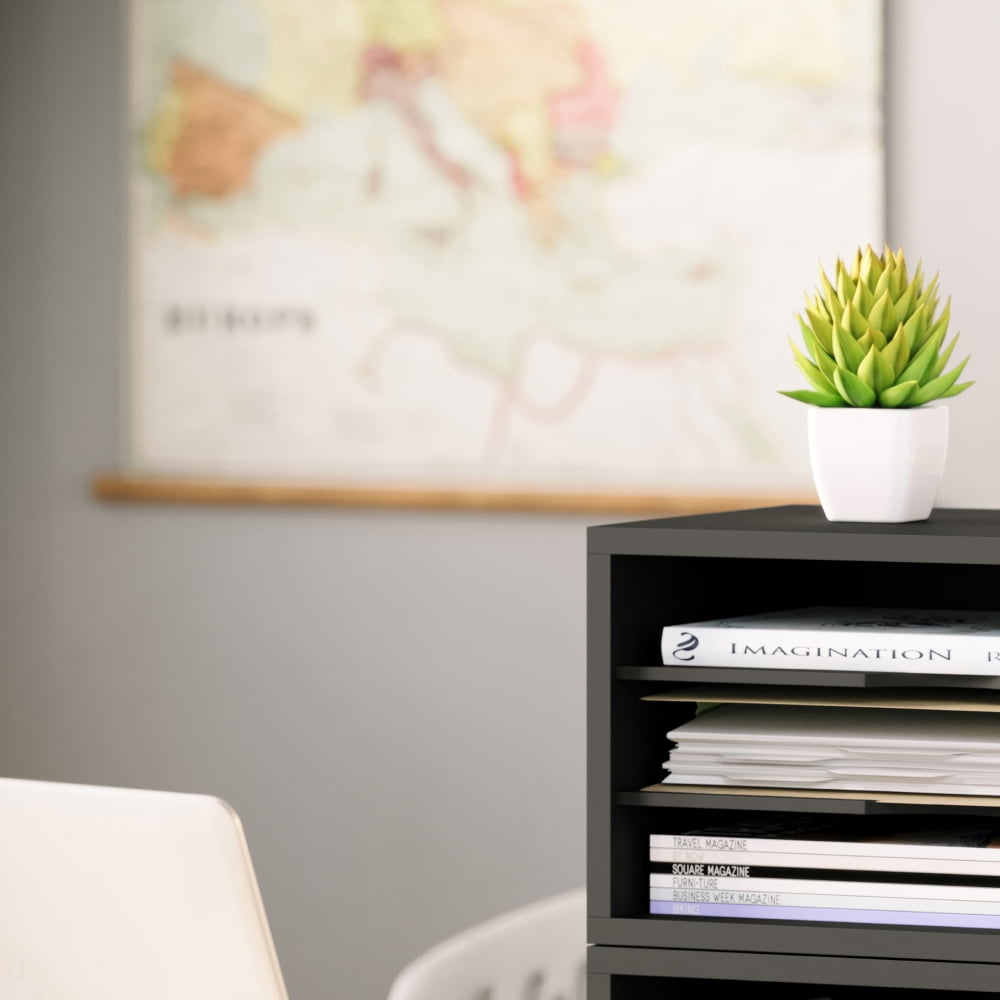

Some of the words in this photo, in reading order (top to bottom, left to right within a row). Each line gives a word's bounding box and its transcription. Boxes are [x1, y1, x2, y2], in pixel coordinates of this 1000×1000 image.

[730, 643, 952, 661] IMAGINATION
[673, 837, 702, 849] TRAVEL
[706, 839, 748, 851] MAGAZINE
[672, 864, 704, 876] SQUARE
[708, 865, 750, 878] MAGAZINE
[673, 877, 719, 889] FURNI-TURE
[673, 891, 711, 903] BUSINESS
[714, 892, 735, 903] WEEK
[738, 893, 781, 905] MAGAZINE
